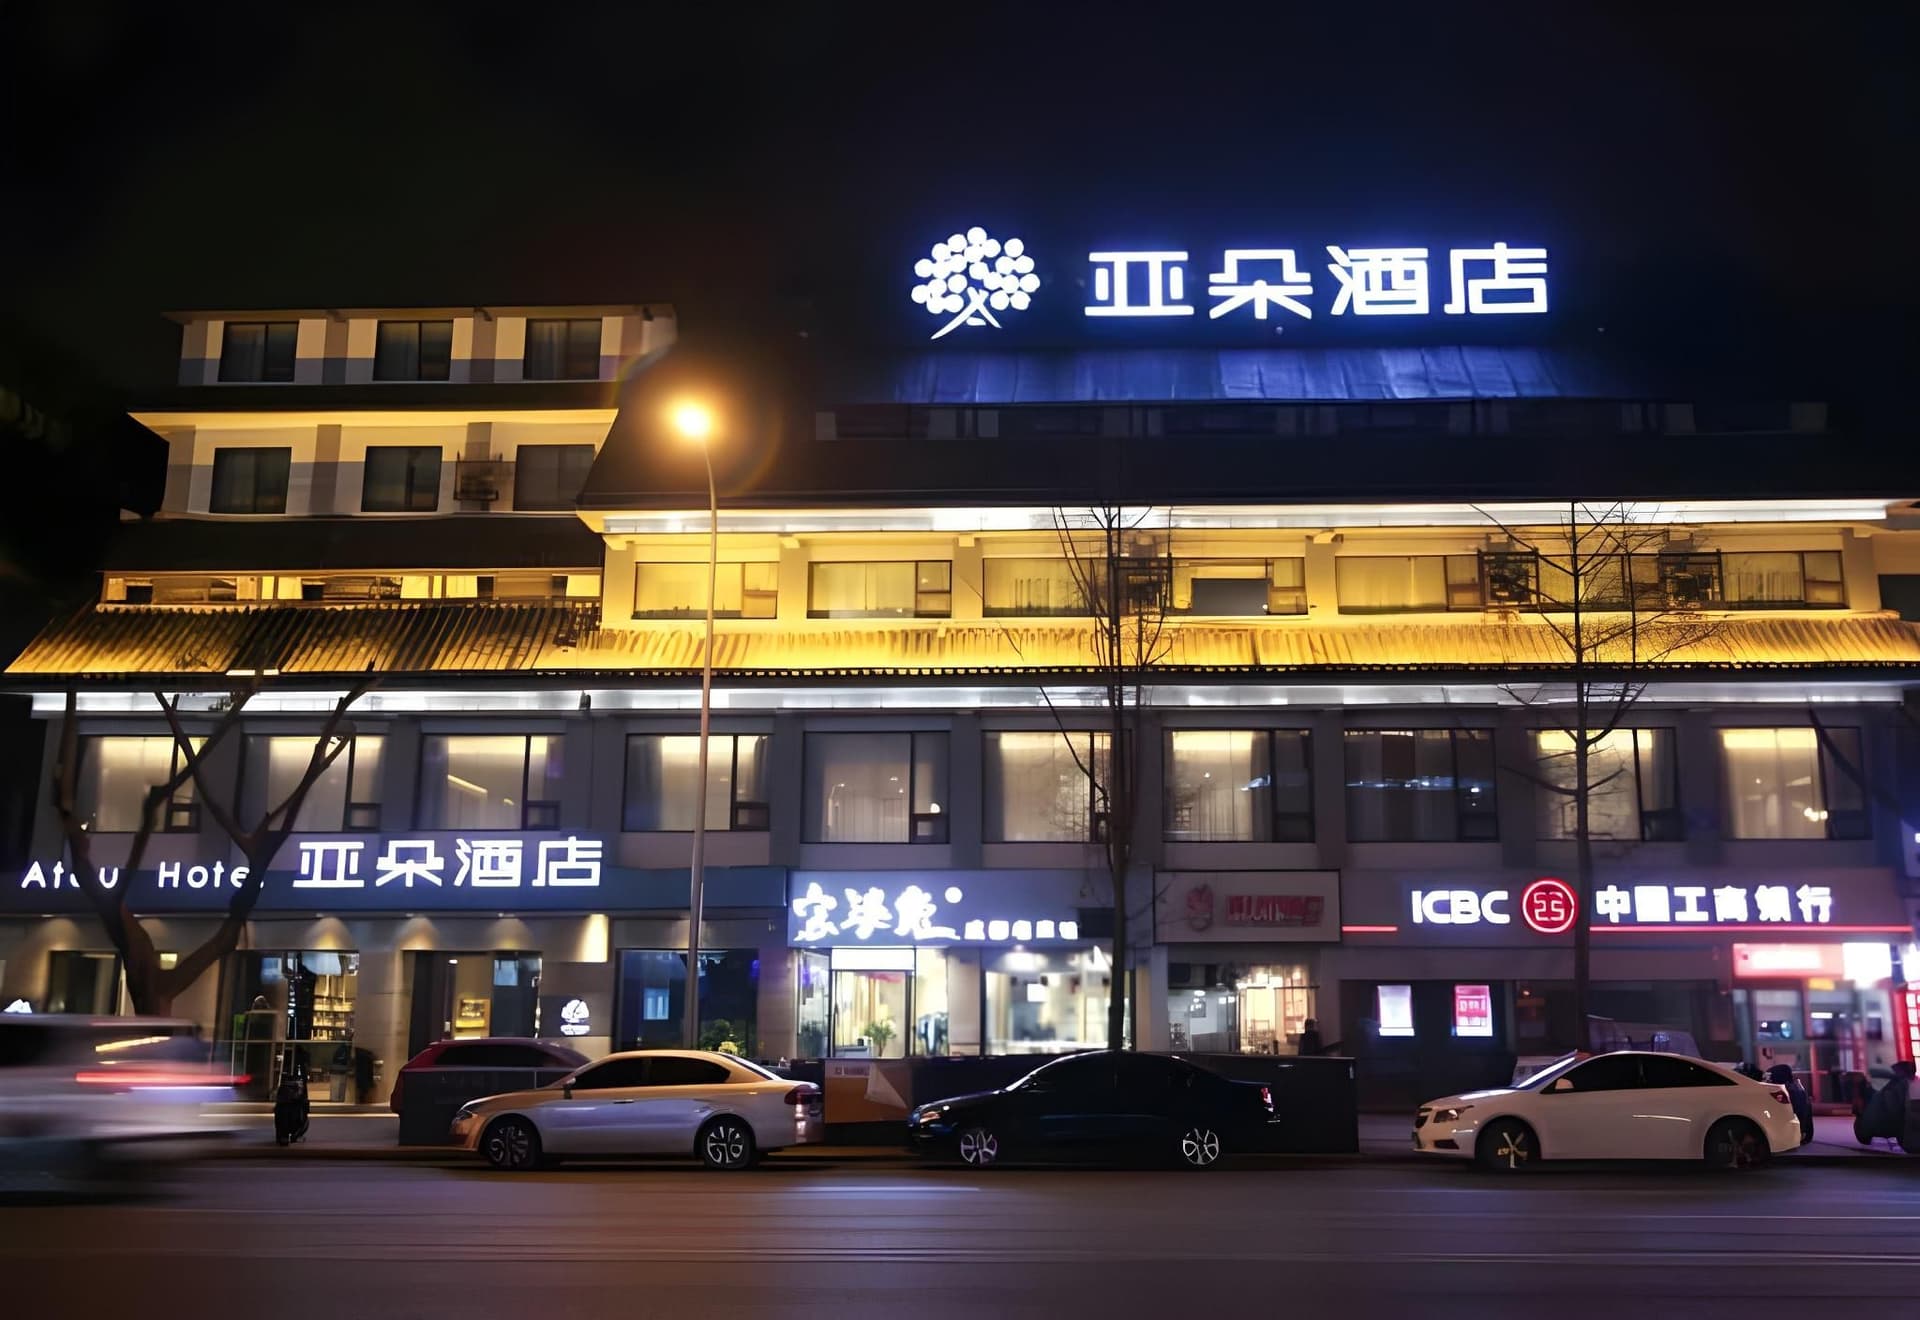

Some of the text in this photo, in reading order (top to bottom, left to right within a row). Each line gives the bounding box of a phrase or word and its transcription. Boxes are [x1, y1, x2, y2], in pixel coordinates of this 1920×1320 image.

[1085, 242, 1548, 319] 亚朵酒店
[158, 861, 264, 888] Hote
[293, 836, 603, 887] 亚朵酒店
[1411, 890, 1511, 924] ICBC
